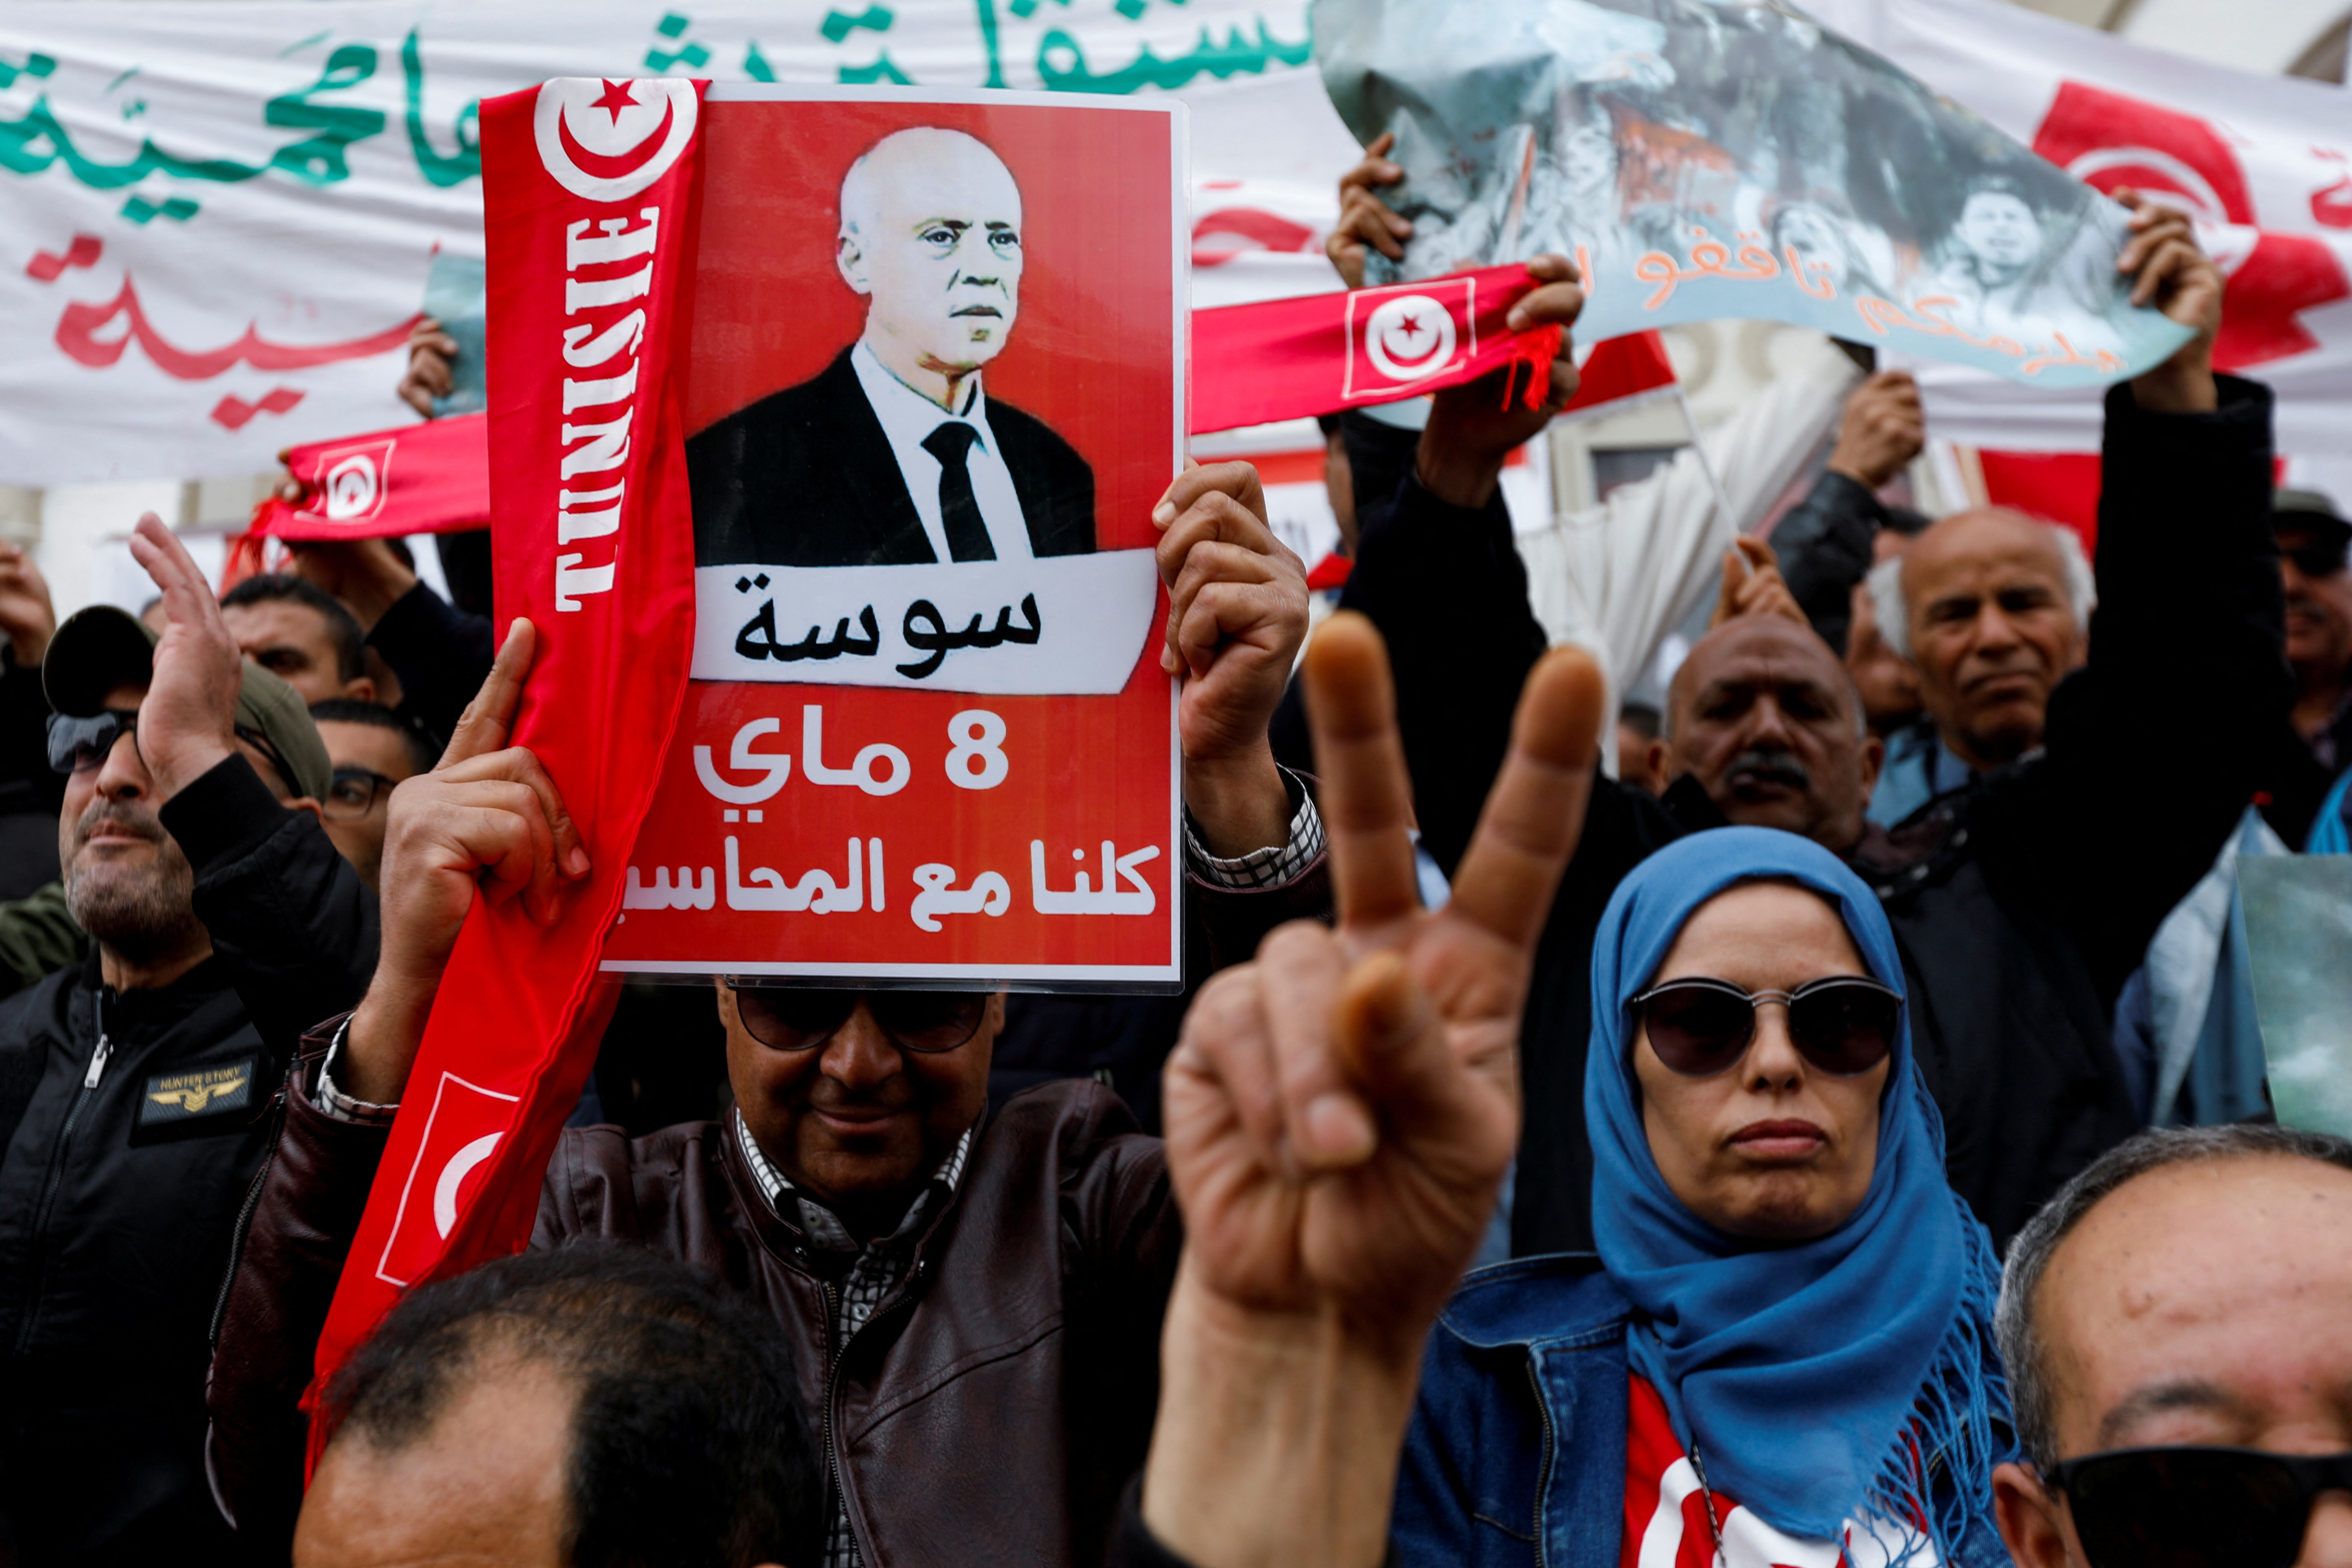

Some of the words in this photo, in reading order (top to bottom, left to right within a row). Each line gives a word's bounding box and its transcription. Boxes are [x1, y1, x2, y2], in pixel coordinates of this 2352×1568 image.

[555, 206, 660, 612] TUNISIE
[734, 572, 1042, 680] سوسة
[693, 703, 911, 823] ماي
[944, 708, 1009, 790] 8
[617, 835, 886, 925] المحاسب
[910, 862, 1011, 933] مع
[1029, 838, 1161, 915] كلنا
